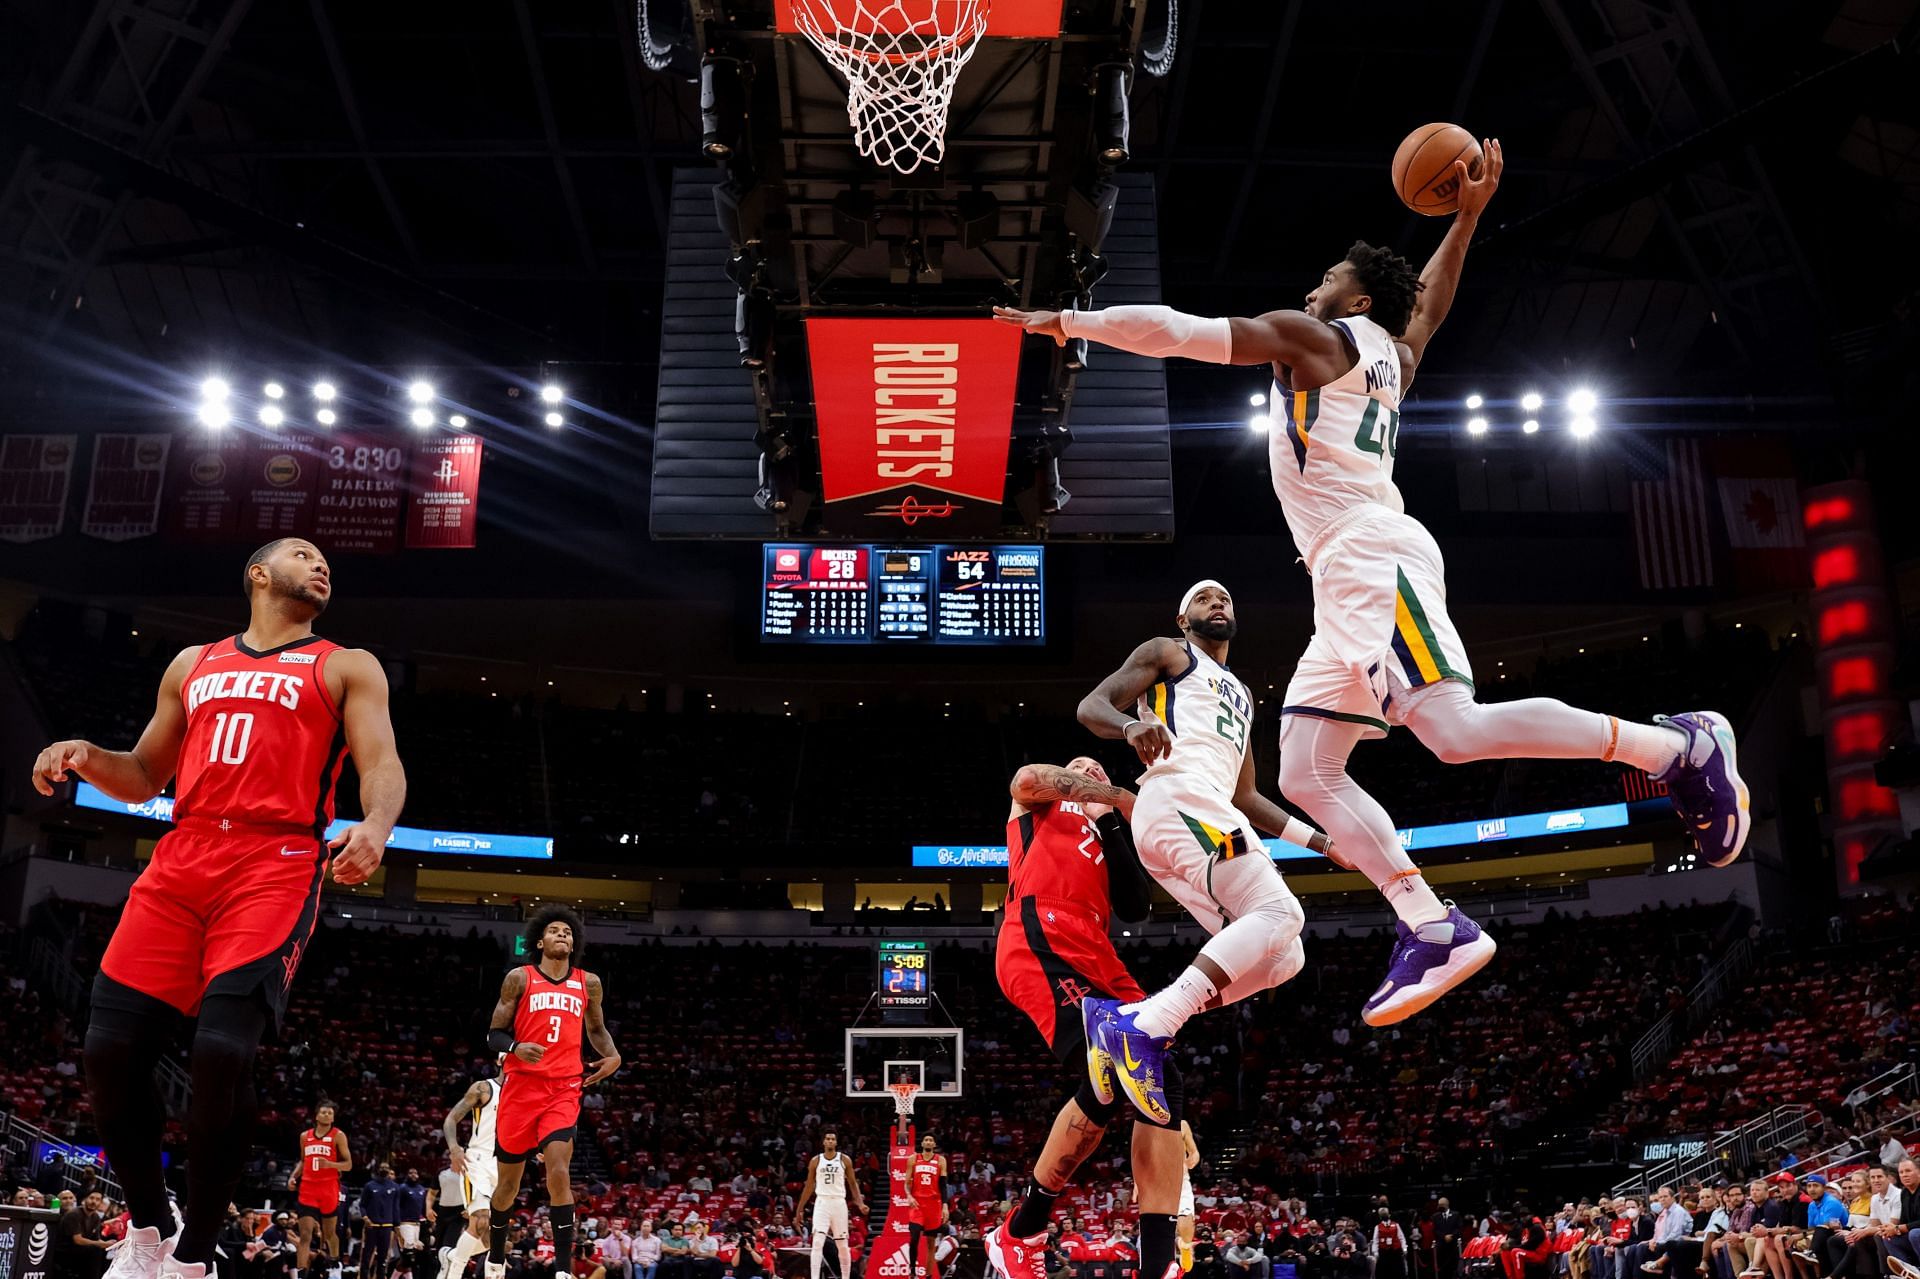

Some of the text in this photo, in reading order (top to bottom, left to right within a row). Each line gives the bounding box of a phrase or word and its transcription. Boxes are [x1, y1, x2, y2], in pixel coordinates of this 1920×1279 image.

[873, 343, 959, 478] ROCKETS
[332, 479, 395, 491] HAKEEM
[320, 495, 398, 509] OLAJUWON
[946, 551, 989, 561] JAZZ
[828, 561, 855, 579] 28
[958, 561, 985, 580] 54
[188, 670, 304, 716] ROCKETS
[1216, 700, 1246, 756] 23
[209, 712, 254, 765] 10
[894, 954, 925, 969] 5:08
[889, 969, 920, 992] 21
[529, 991, 583, 1018] ROCKETS
[546, 1015, 562, 1042] 3
[1643, 1144, 1672, 1160] LIGHT
[824, 1173, 835, 1184] 21
[920, 1173, 931, 1185] 35
